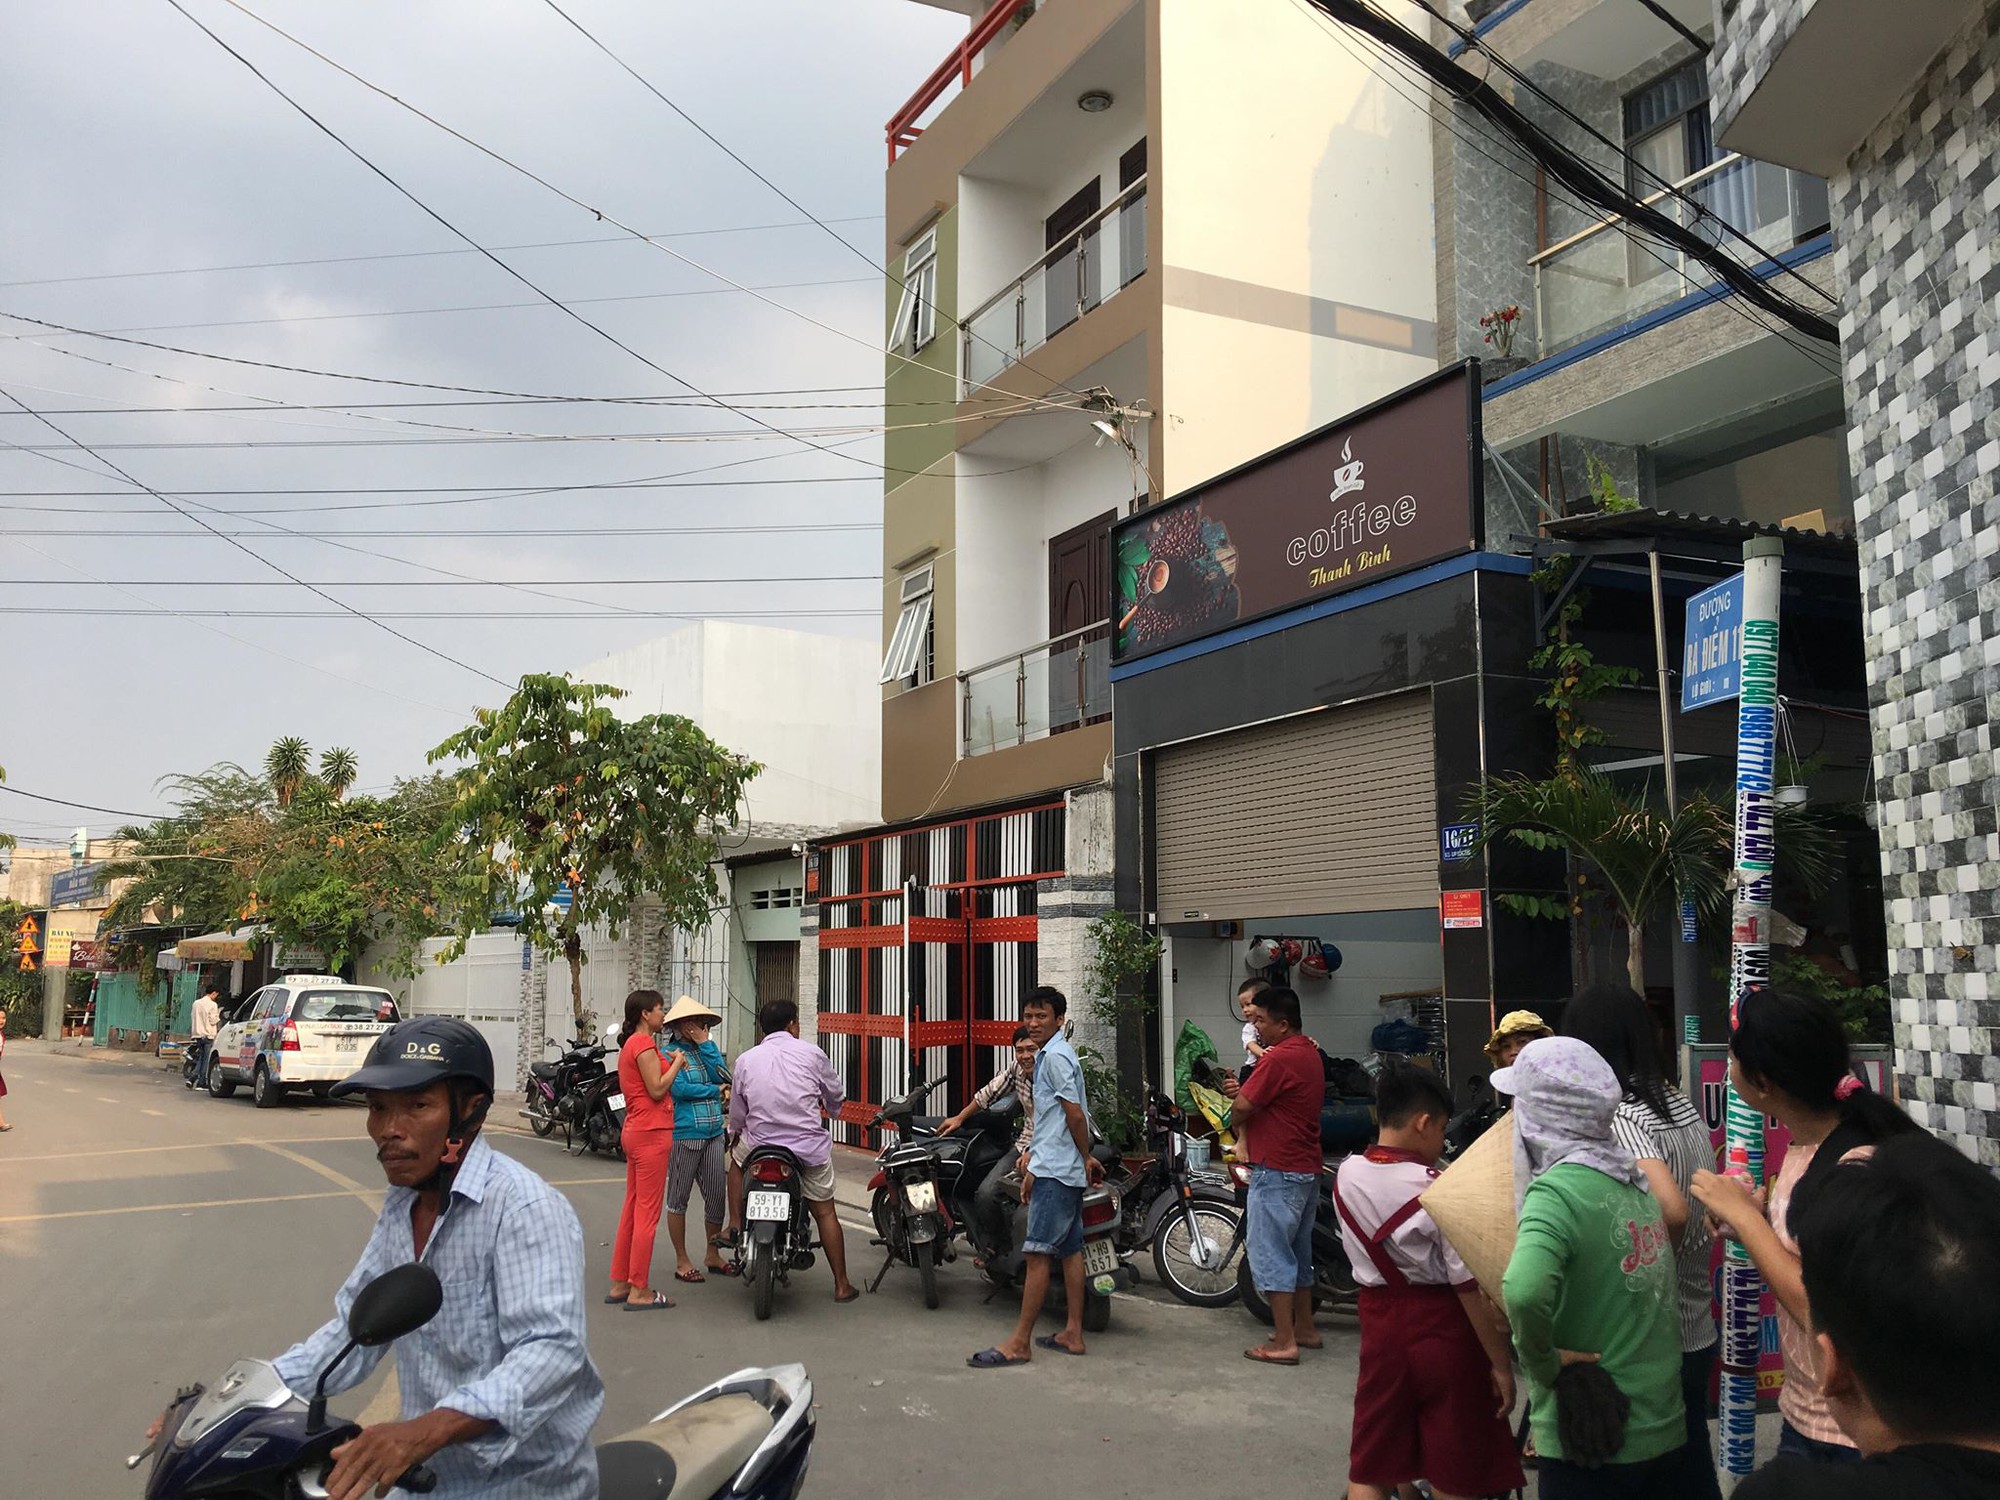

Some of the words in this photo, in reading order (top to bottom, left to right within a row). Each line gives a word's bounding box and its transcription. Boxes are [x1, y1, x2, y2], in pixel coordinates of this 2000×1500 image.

[1286, 494, 1417, 566] coffee
[1309, 557, 1352, 588] Thanh
[1355, 543, 1392, 572] Bình
[1699, 591, 1731, 622] ĐƯỜNG
[1686, 633, 1698, 678] BÀ
[1701, 615, 1729, 672] ĐIỂM
[750, 1206, 786, 1219] 813.56
[754, 1194, 782, 1206] 59-Y1
